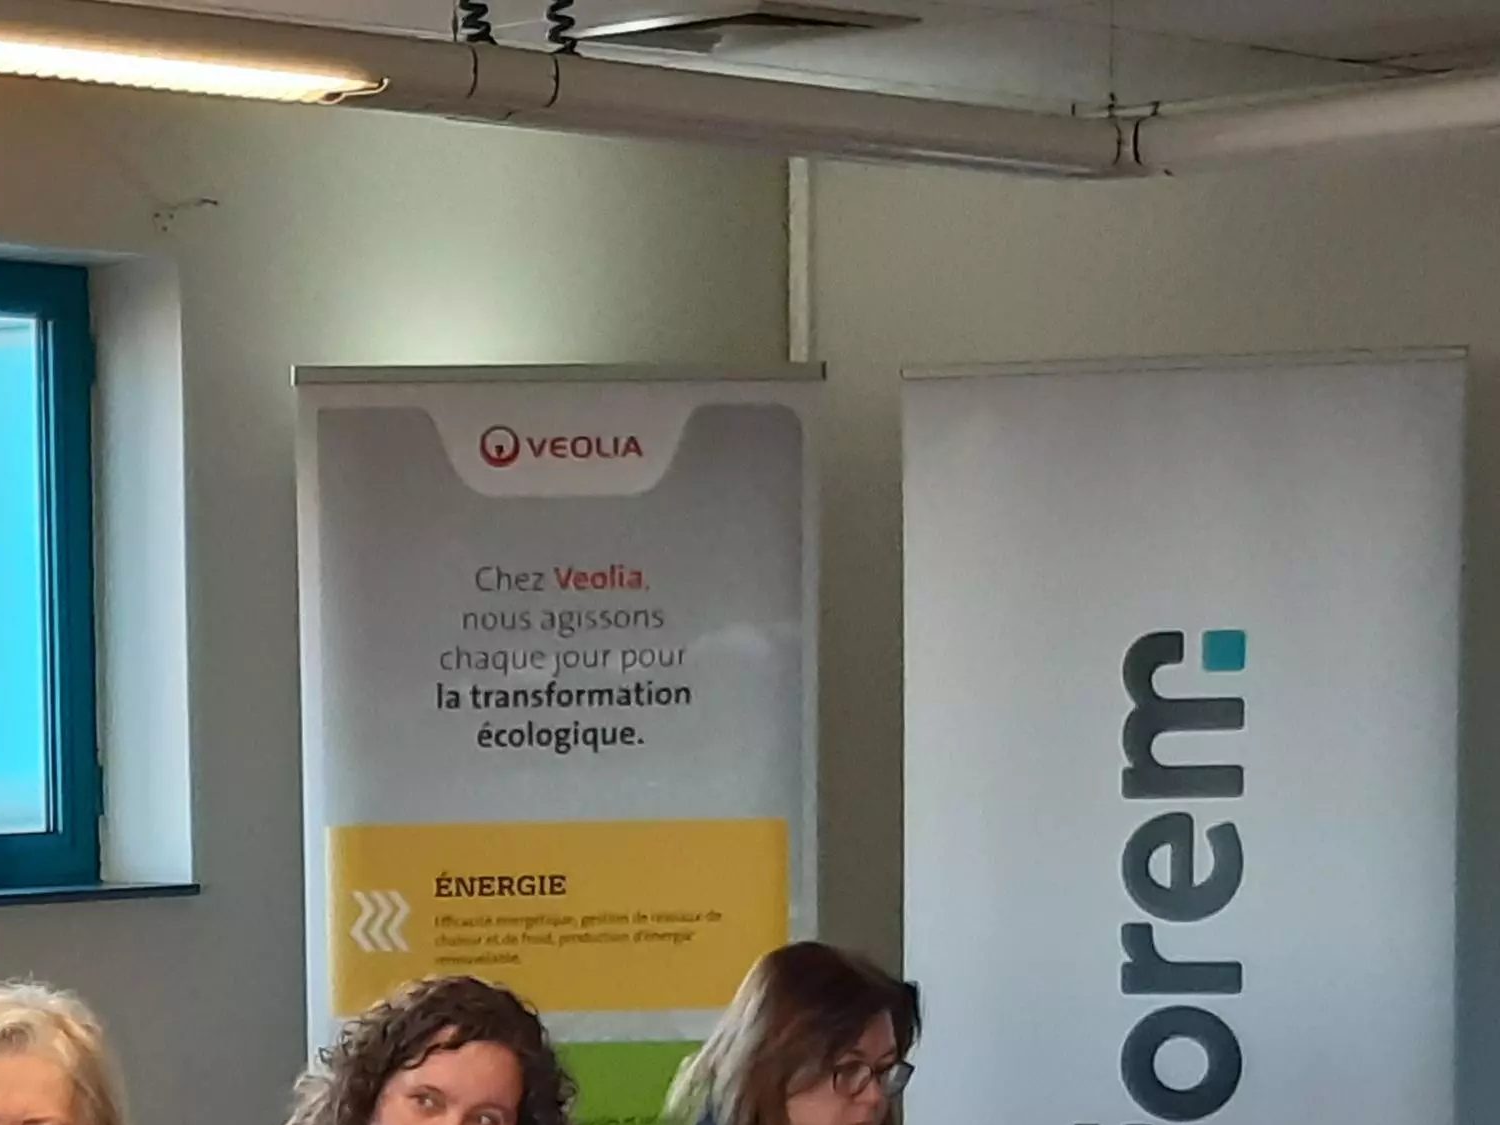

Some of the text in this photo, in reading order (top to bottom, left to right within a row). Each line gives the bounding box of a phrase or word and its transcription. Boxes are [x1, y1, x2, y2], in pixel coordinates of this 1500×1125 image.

[525, 435, 644, 459] VEOLIA
[475, 565, 545, 593] Chez
[462, 607, 666, 639] nous agissons
[439, 645, 687, 678] chaque jour pour
[436, 680, 692, 710] la transformation
[476, 719, 646, 755] écologique.
[434, 871, 567, 898] ÉNERGIE
